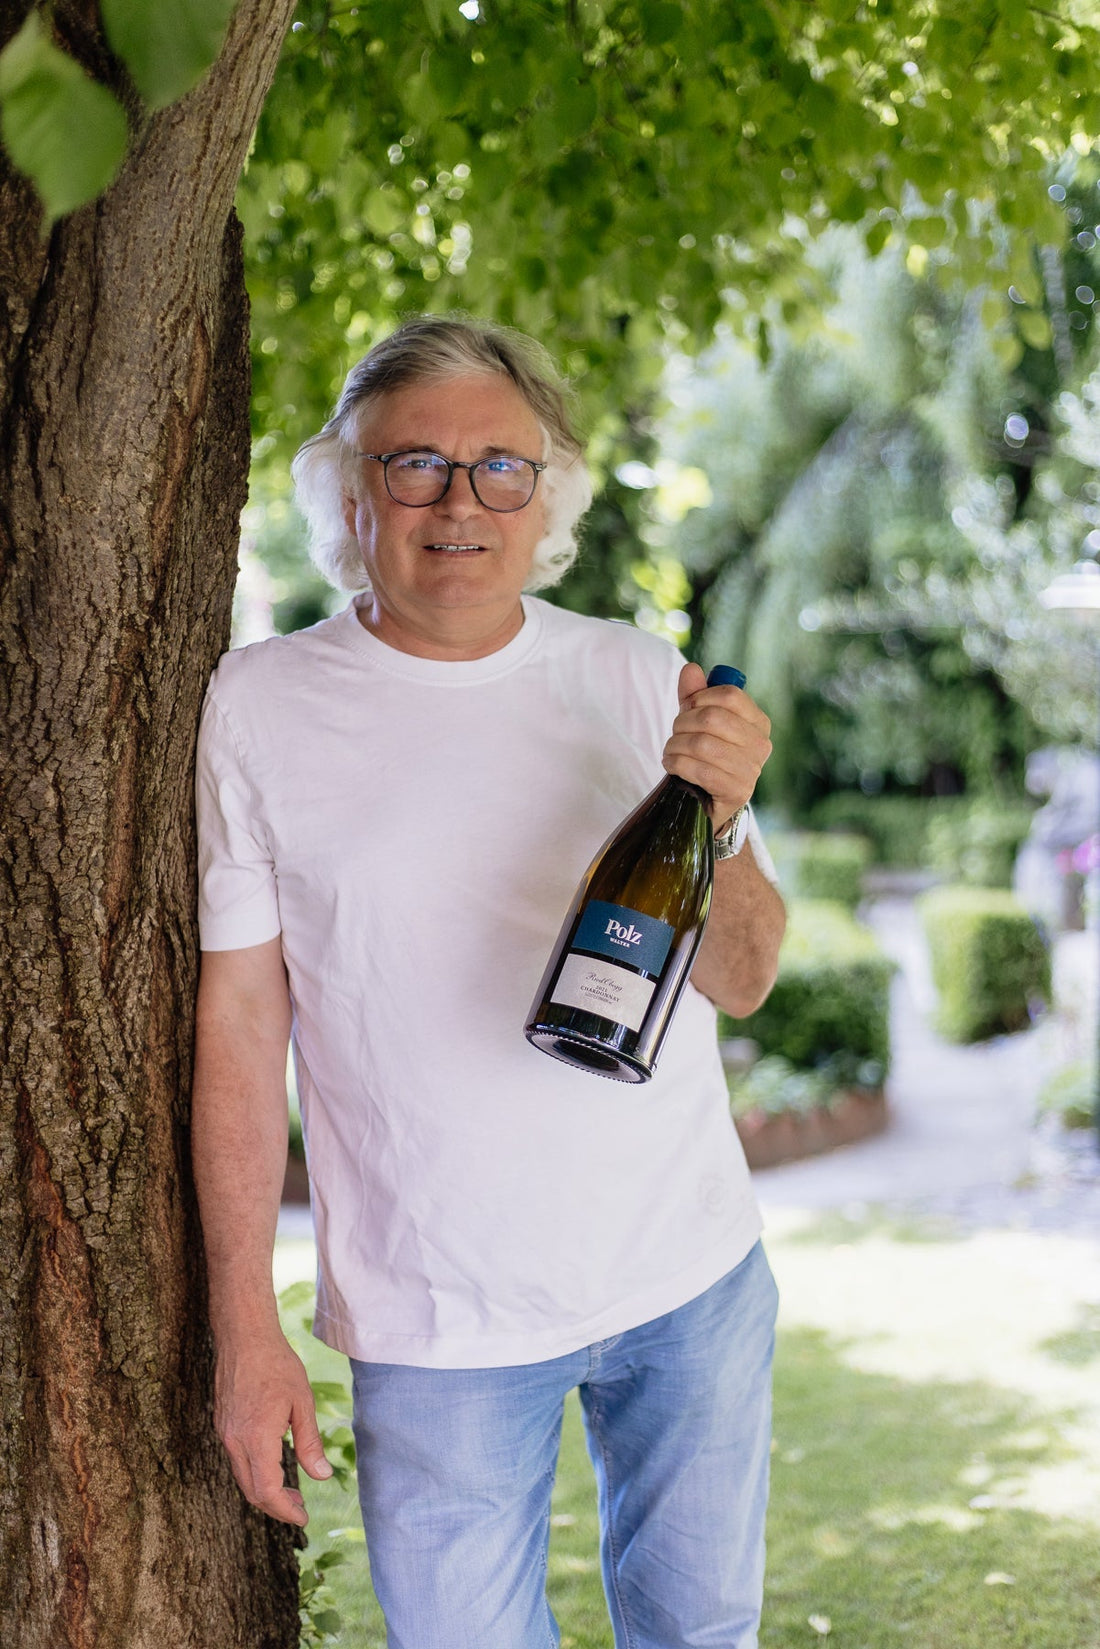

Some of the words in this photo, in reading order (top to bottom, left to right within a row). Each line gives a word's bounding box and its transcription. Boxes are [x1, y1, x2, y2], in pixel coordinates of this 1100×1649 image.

[604, 918, 643, 945] Polz
[610, 937, 630, 948] WALTER
[580, 985, 620, 1002] CHARDONNAY
